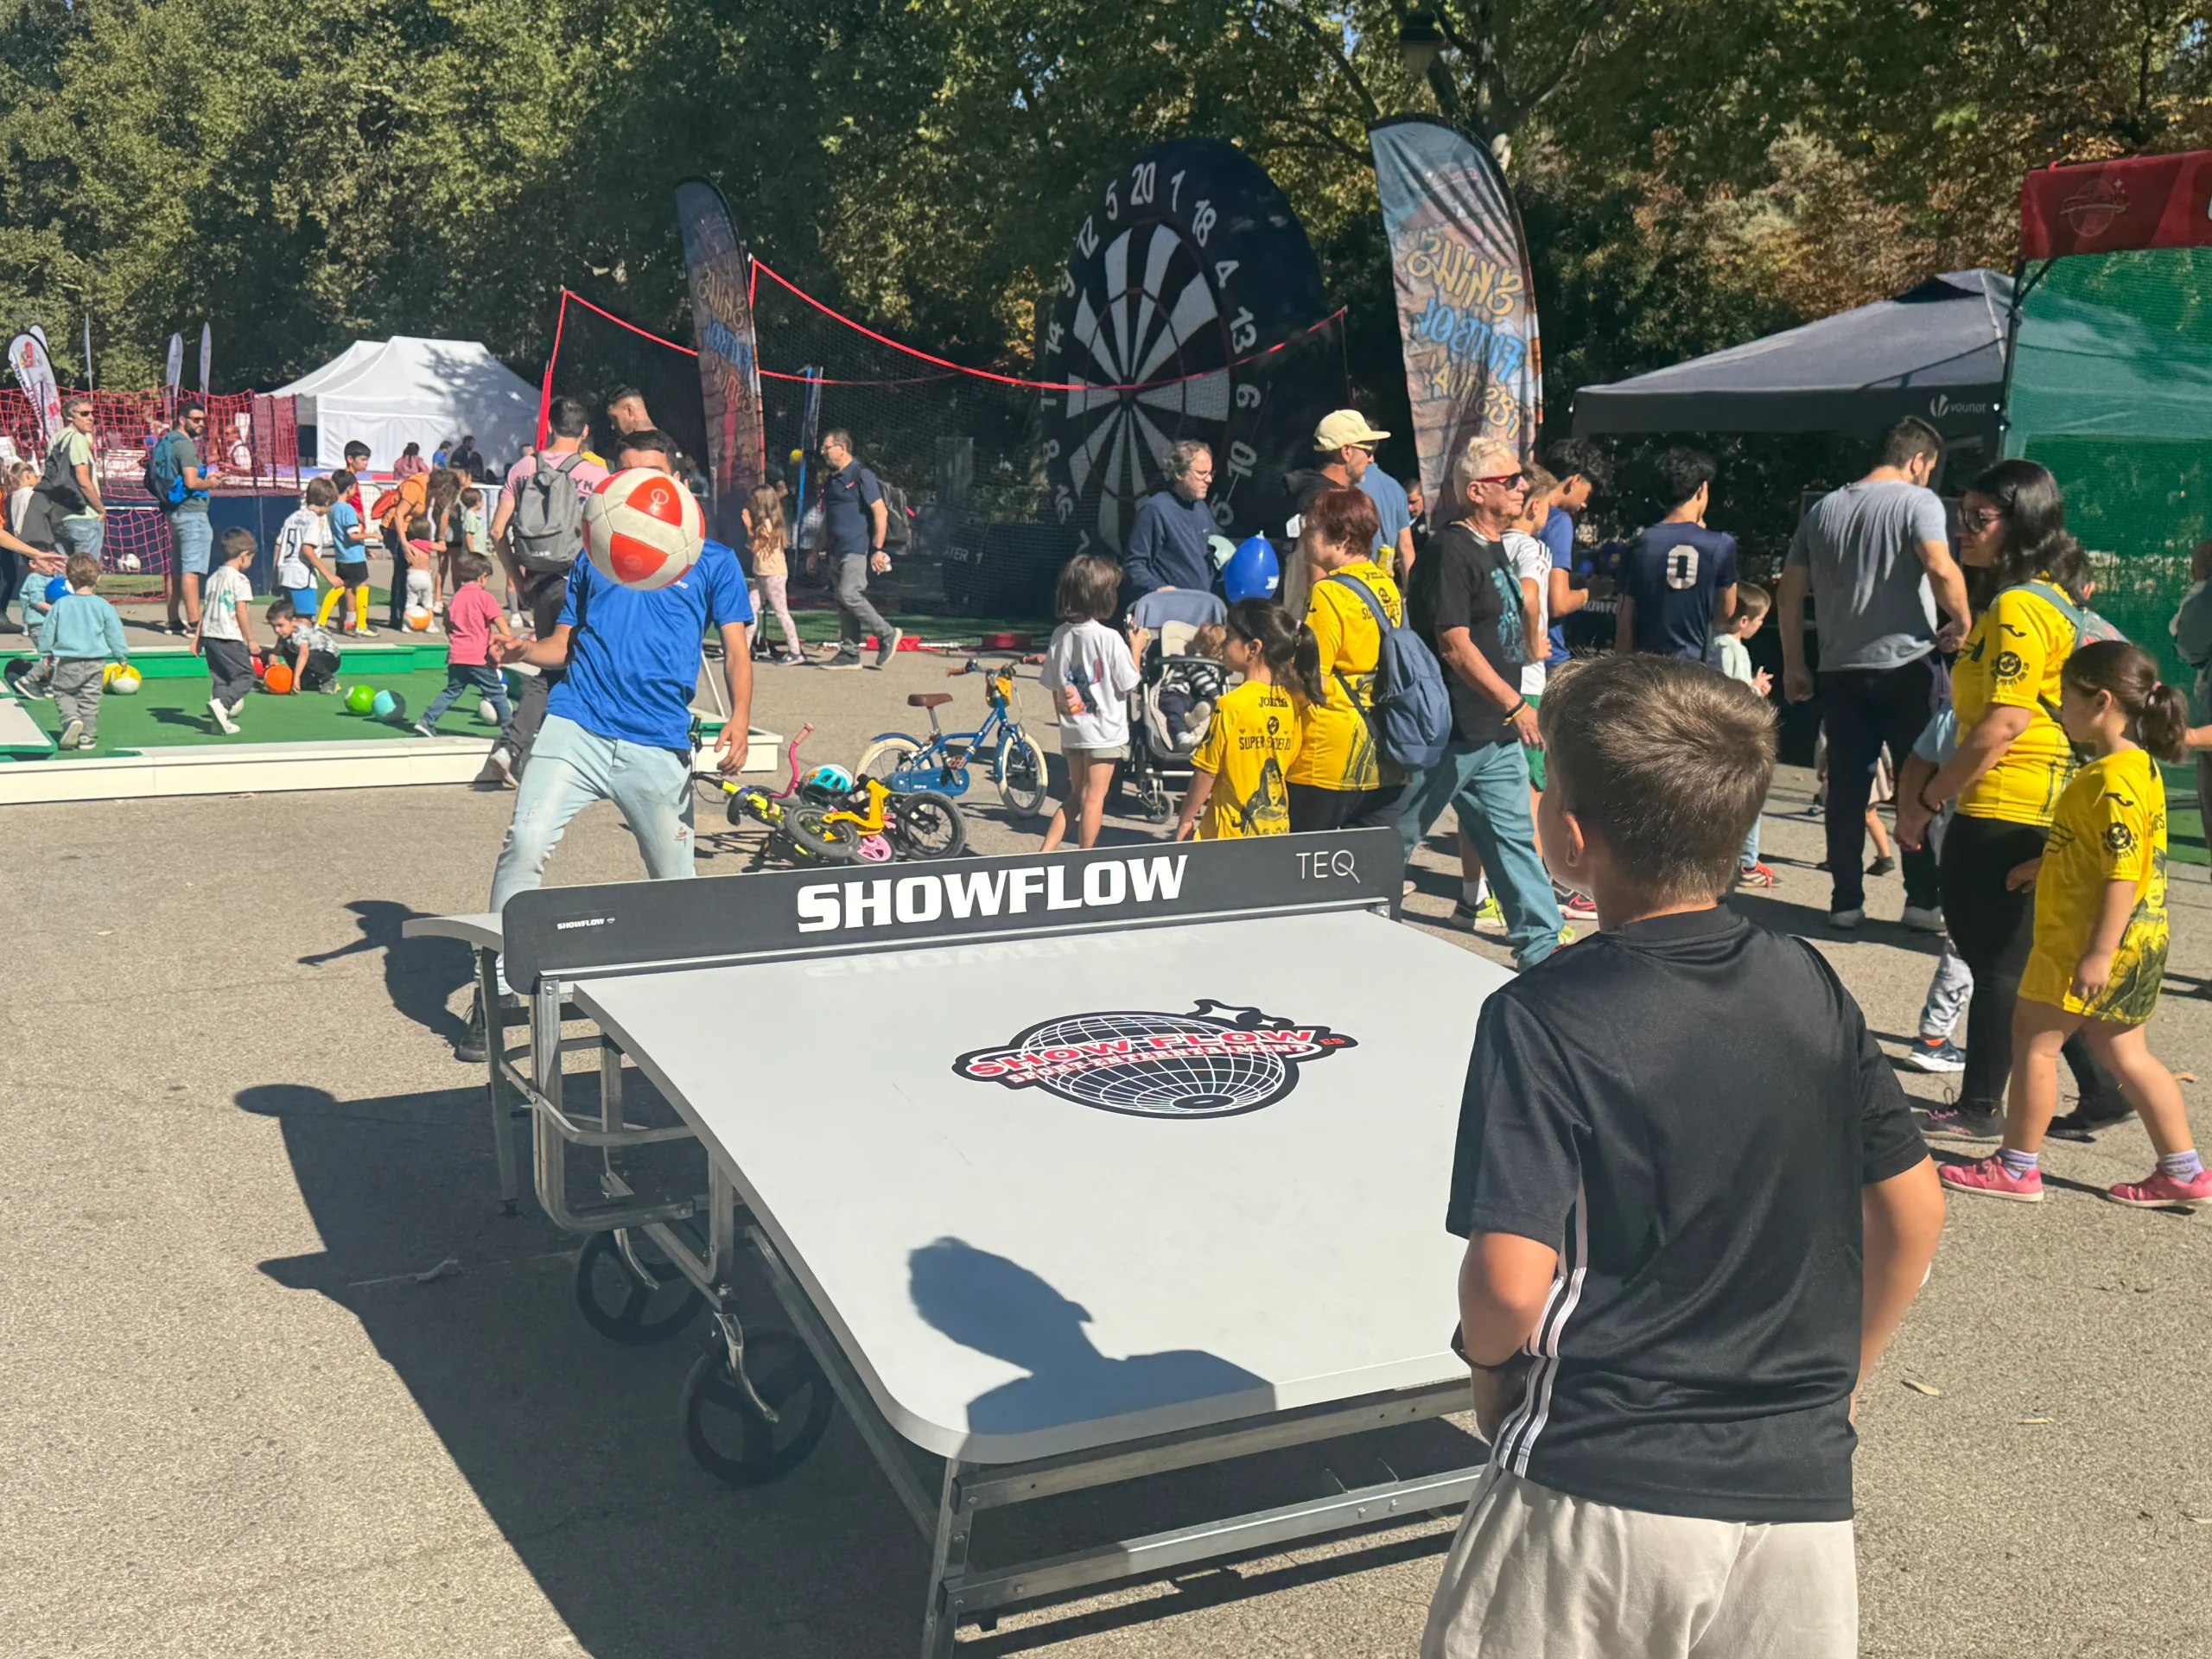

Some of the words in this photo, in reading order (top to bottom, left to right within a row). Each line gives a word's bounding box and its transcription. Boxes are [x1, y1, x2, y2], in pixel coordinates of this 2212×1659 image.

[1105, 179, 1118, 220] 5
[1130, 162, 1156, 206] 20
[1171, 169, 1186, 213] 1
[1076, 214, 1100, 259] 12
[1192, 199, 1217, 248] 18
[1061, 268, 1076, 298] 9
[1215, 260, 1240, 289] 4
[1045, 321, 1065, 355] 14
[1230, 306, 1257, 355] 13
[1043, 439, 1060, 464] 8
[1227, 441, 1258, 478] 10
[1666, 544, 1700, 589] 0
[798, 855, 1188, 933] SHOWFLOW
[1295, 849, 1361, 884] TEQ
[557, 918, 605, 931] SHOWFLOW
[969, 1039, 1131, 1077] SHOW
[1143, 1029, 1316, 1050] FLOW
